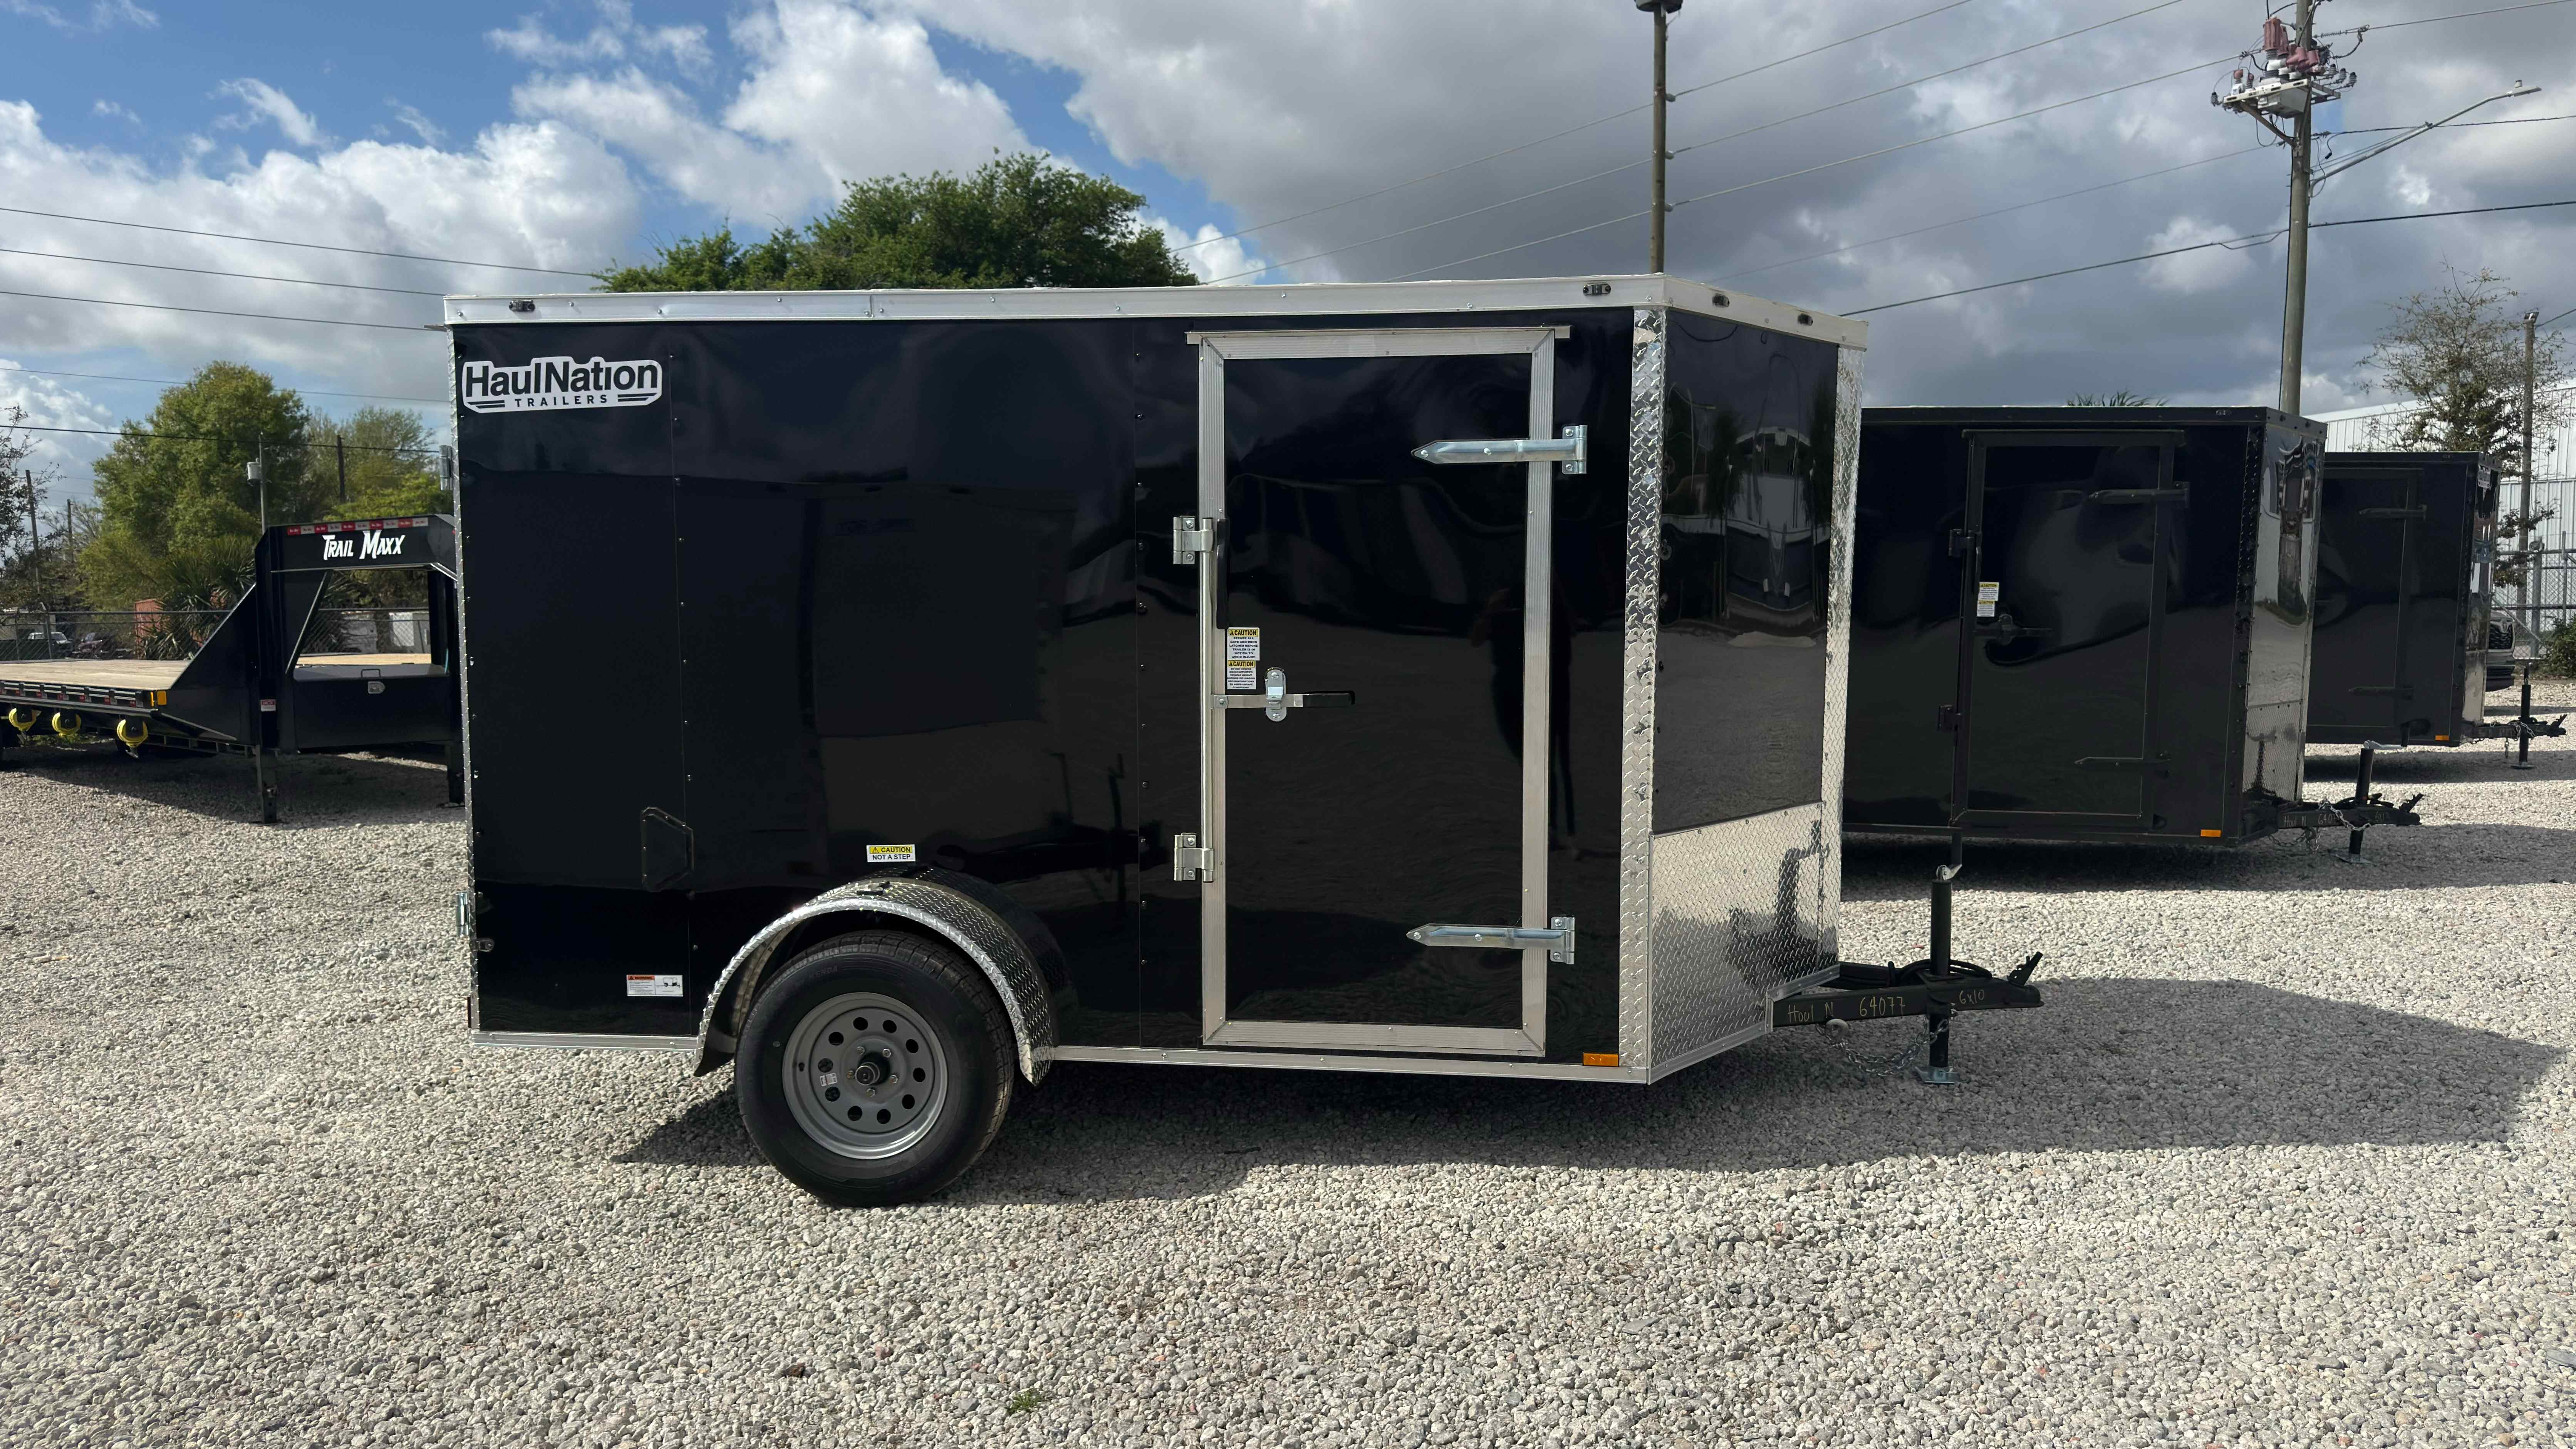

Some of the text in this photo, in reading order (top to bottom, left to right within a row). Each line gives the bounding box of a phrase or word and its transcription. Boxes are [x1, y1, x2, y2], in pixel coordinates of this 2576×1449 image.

[465, 361, 658, 397] HaulNation
[515, 394, 607, 408] TRAILERS
[322, 529, 406, 560] TRAIL MAXX
[1859, 996, 1906, 1017] 64077
